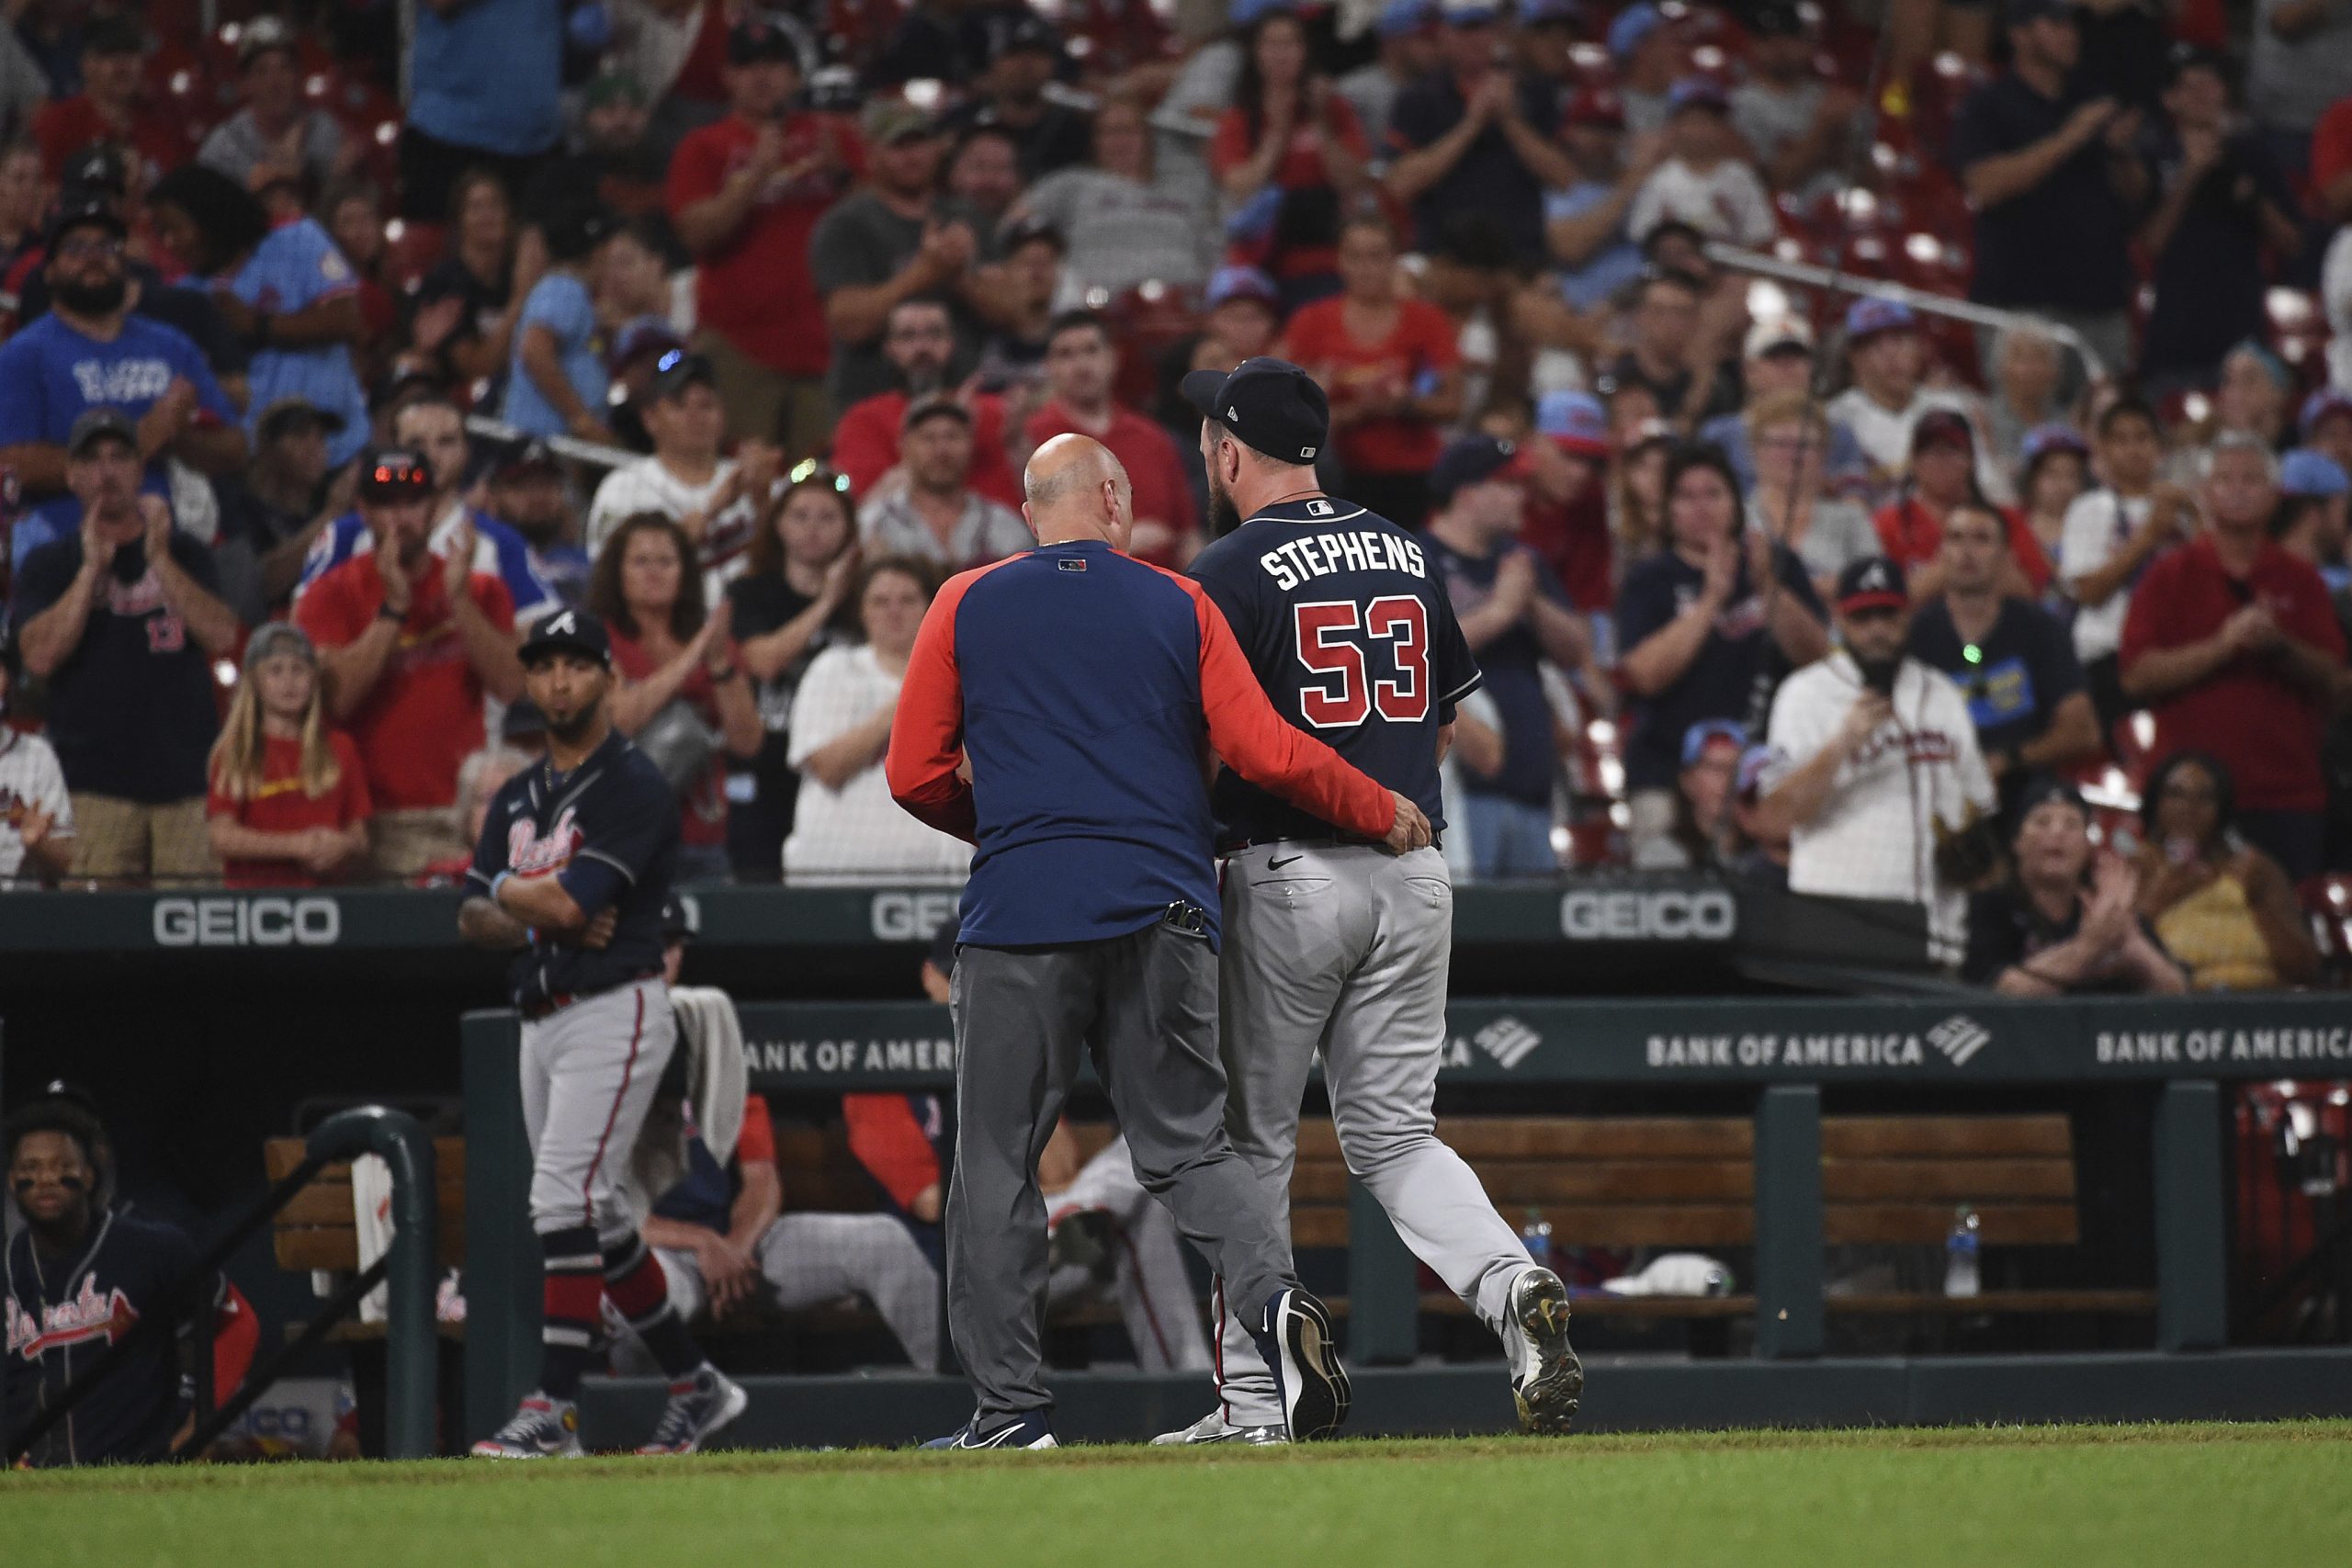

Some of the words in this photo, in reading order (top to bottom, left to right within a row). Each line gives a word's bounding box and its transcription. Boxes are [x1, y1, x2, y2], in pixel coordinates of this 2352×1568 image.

[1260, 531, 1426, 592] STEPHENS
[545, 611, 576, 636] A
[1294, 593, 1430, 728] 53
[153, 897, 341, 946] GEICO
[1560, 890, 1736, 941] GEICO
[743, 1041, 808, 1071] ANK
[816, 1040, 856, 1071] OF
[864, 1040, 955, 1071] AMER
[1646, 1034, 1733, 1066] BANK
[1737, 1034, 1779, 1066] OF
[1782, 1033, 1923, 1066] AMERICA
[2097, 1032, 2180, 1064] BANK
[2185, 1030, 2226, 1061] OF
[2231, 1028, 2352, 1060] AMERIC
